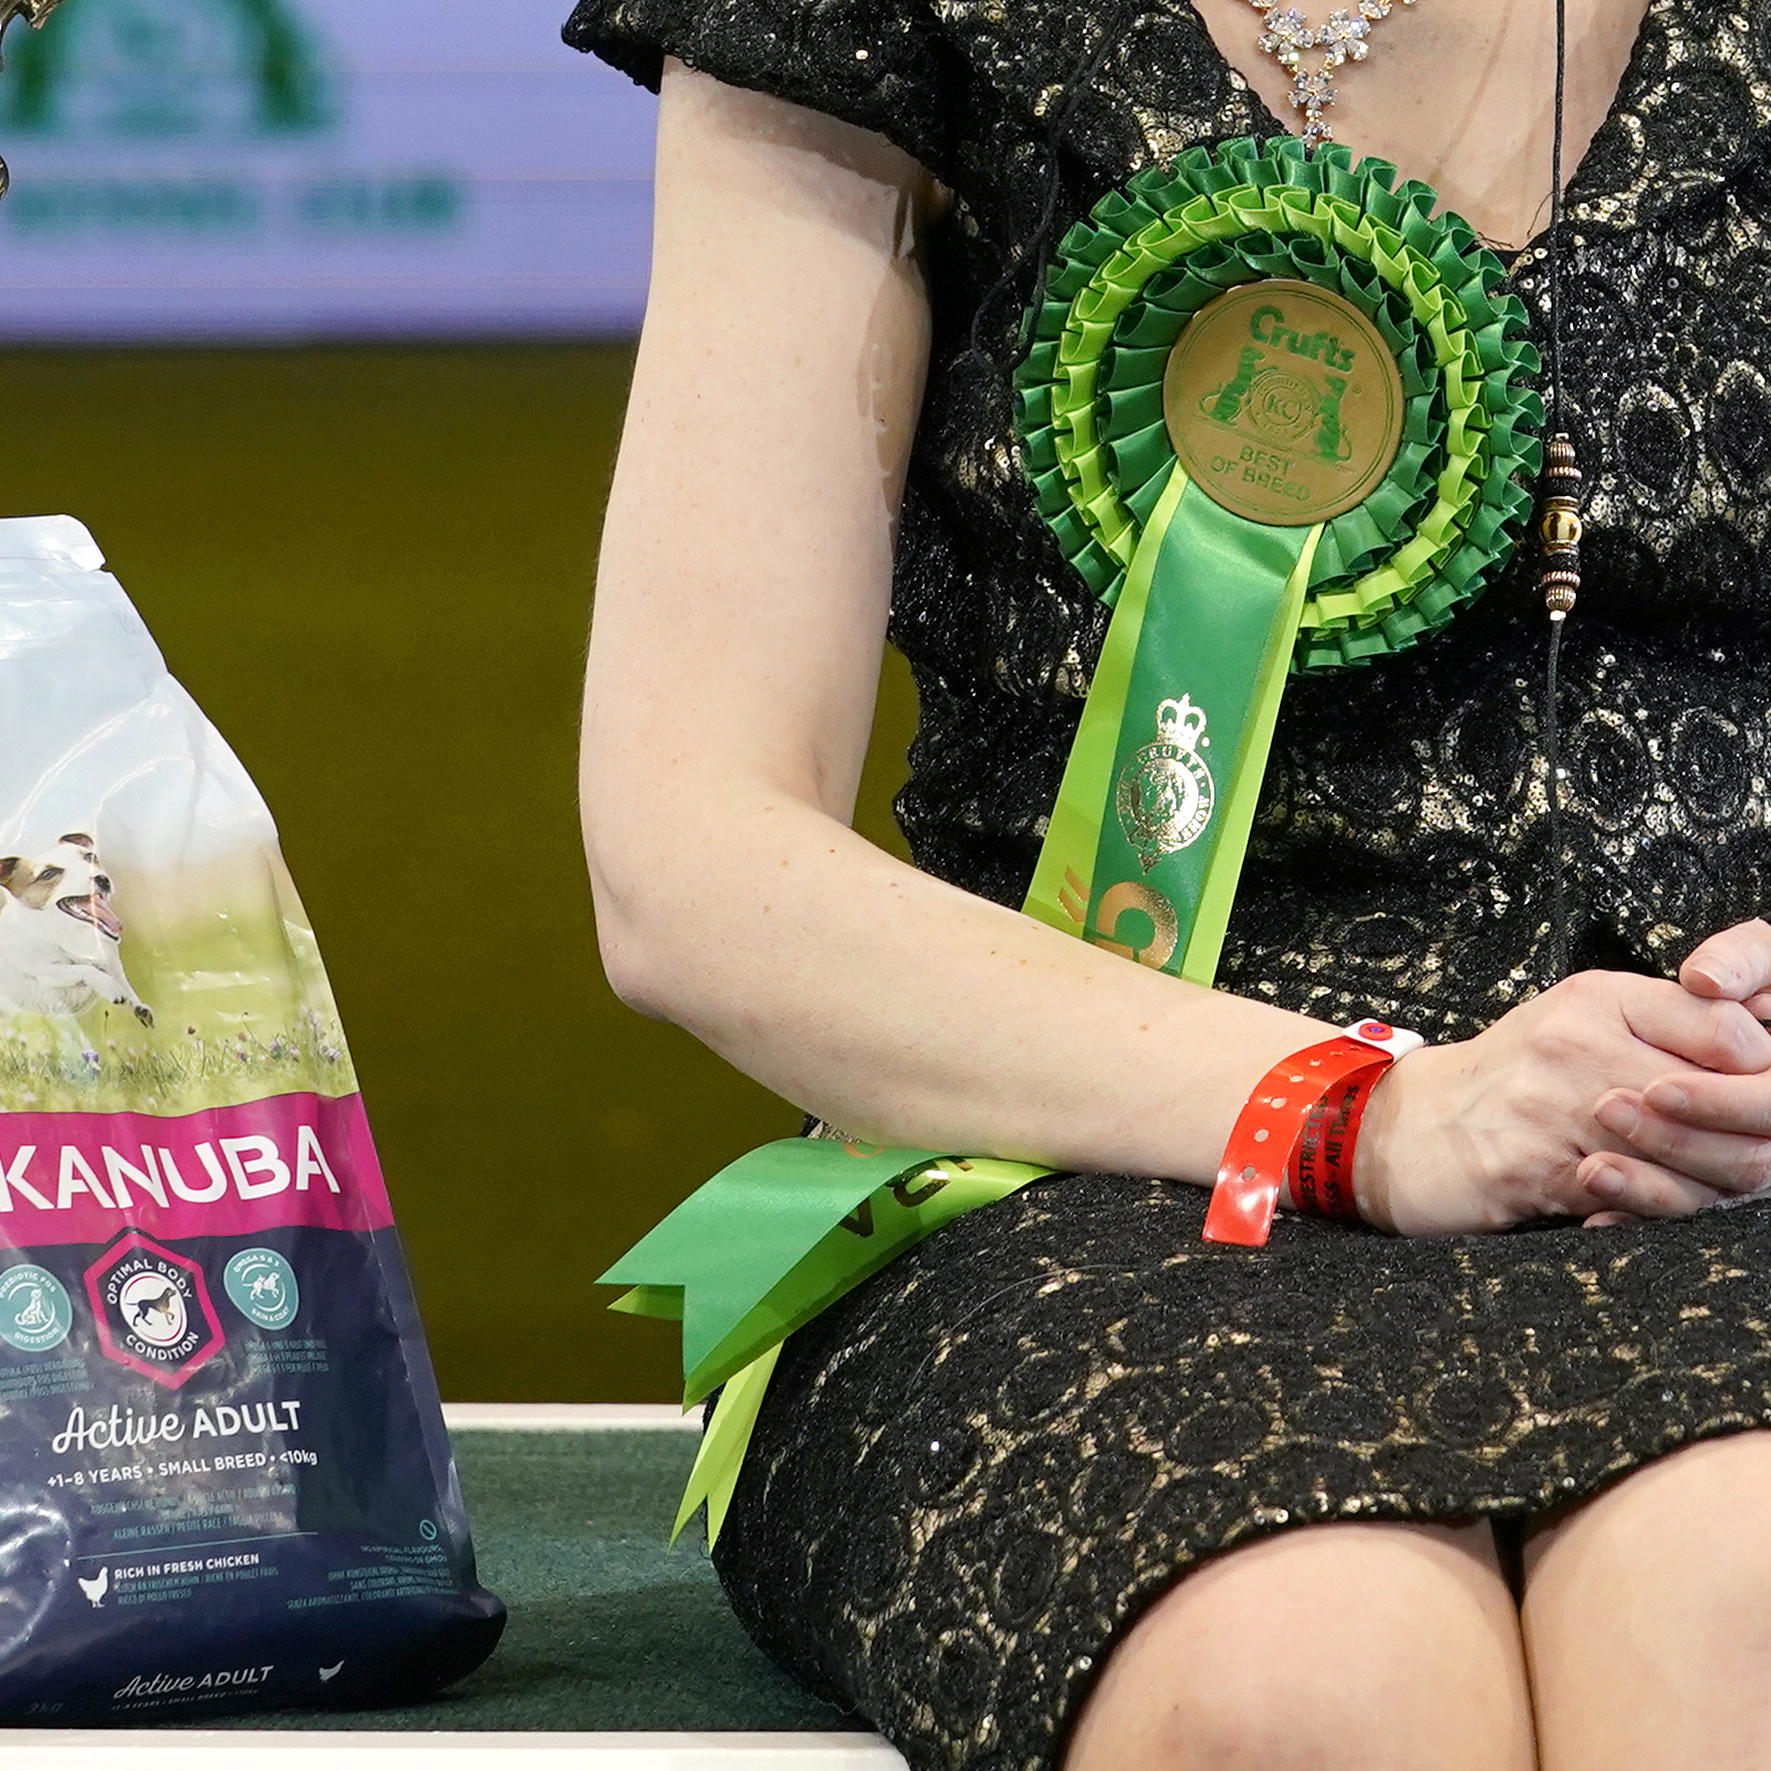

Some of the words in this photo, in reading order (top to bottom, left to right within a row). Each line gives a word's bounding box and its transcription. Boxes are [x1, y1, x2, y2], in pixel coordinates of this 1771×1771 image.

[1250, 305, 1355, 373] Crufts
[1239, 446, 1295, 476] BEST
[1210, 456, 1239, 474] OF
[1242, 466, 1311, 502] BREED
[107, 1258, 153, 1305] OPTIMAL
[158, 1261, 193, 1299] BODY
[14, 1327, 60, 1344] DIGESTION
[126, 1331, 199, 1361] CONDITION
[52, 1404, 185, 1454] Active
[193, 1401, 300, 1439] ADULT
[88, 1465, 143, 1484] YEARS
[158, 1459, 210, 1477] SMALL
[215, 1452, 266, 1471] BREED
[279, 1449, 318, 1466] <10kg
[114, 1565, 145, 1580] RICH
[147, 1565, 161, 1575] IN
[163, 1560, 203, 1574] FRESH
[206, 1553, 260, 1569] CHICKEN
[113, 1673, 198, 1699] Active
[197, 1665, 274, 1689] ADULT
